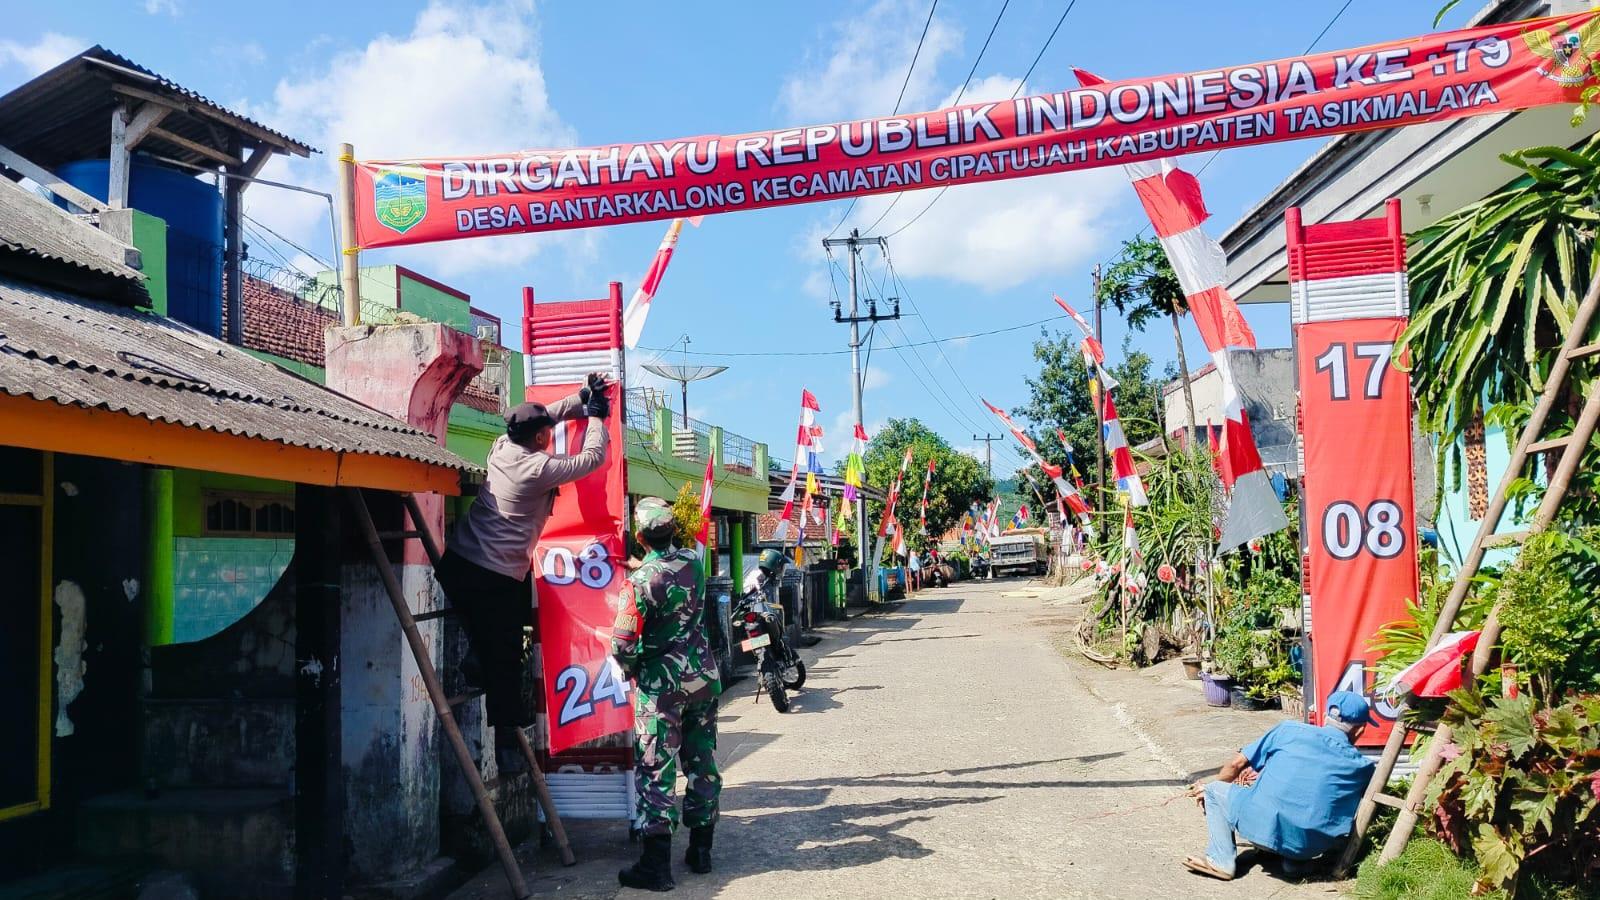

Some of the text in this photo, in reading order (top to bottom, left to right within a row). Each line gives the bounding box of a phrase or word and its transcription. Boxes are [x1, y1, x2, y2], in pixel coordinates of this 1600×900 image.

[442, 139, 721, 199] DIRGAHAYU
[736, 103, 1005, 169] REPUBLIK
[1012, 60, 1321, 136] INDONESIA
[1333, 47, 1413, 88] KE
[456, 80, 1498, 233] DESA BANTARKALONG KECAMATAN CIPATUJAH KABUPATEN TASIKMALAYA
[1315, 341, 1395, 401] 17
[1321, 499, 1406, 560] 08
[543, 543, 615, 589] 08
[555, 655, 632, 726] 24
